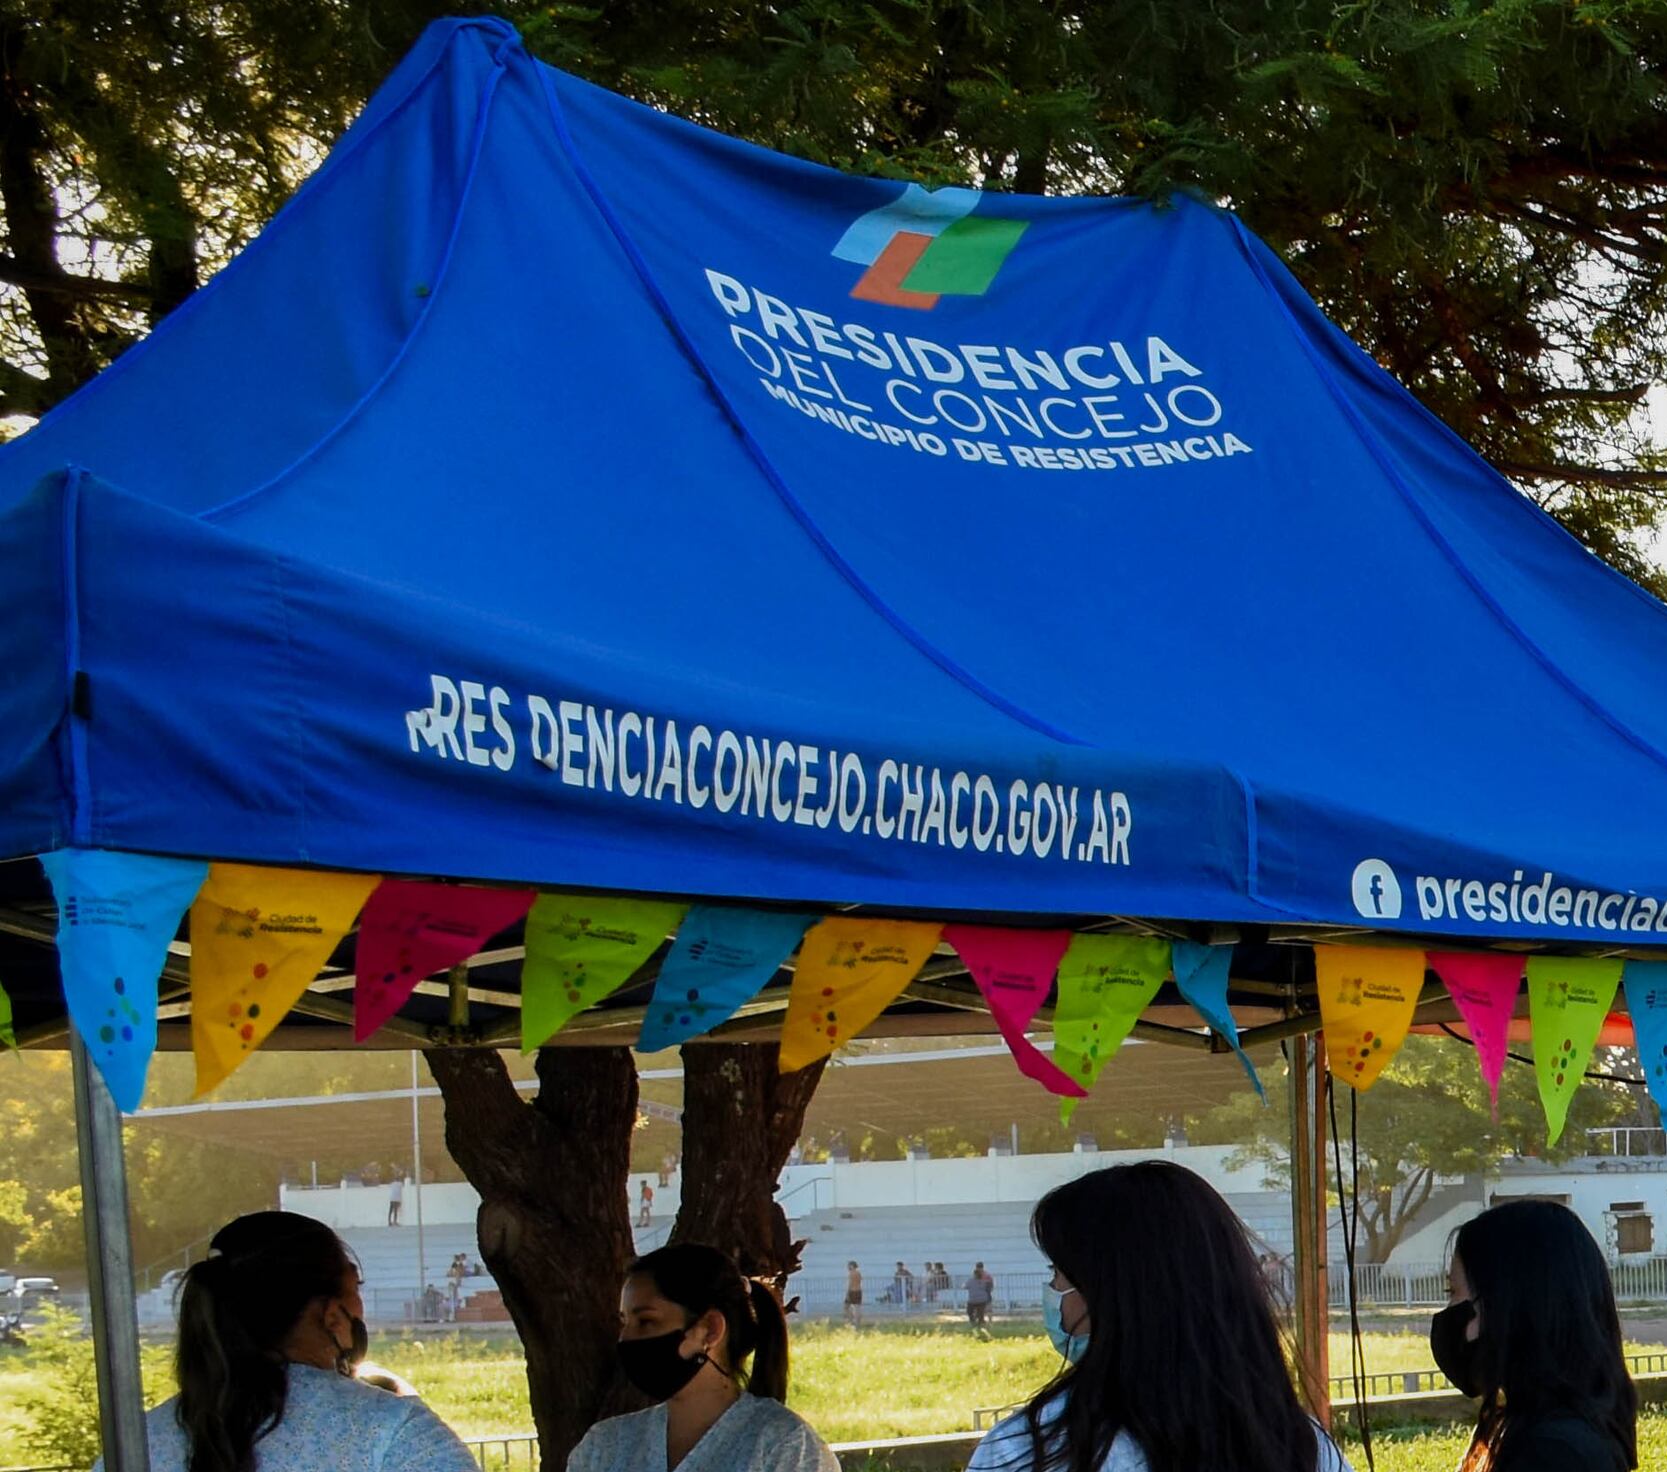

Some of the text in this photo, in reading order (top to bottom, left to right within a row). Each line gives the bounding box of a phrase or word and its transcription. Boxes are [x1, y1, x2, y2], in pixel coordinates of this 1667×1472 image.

[705, 268, 1203, 391] PRESIDENCIA
[729, 324, 1222, 440] DEL CONCEJO
[761, 378, 1253, 470] MUNICIPIO DE RESISTENCIA
